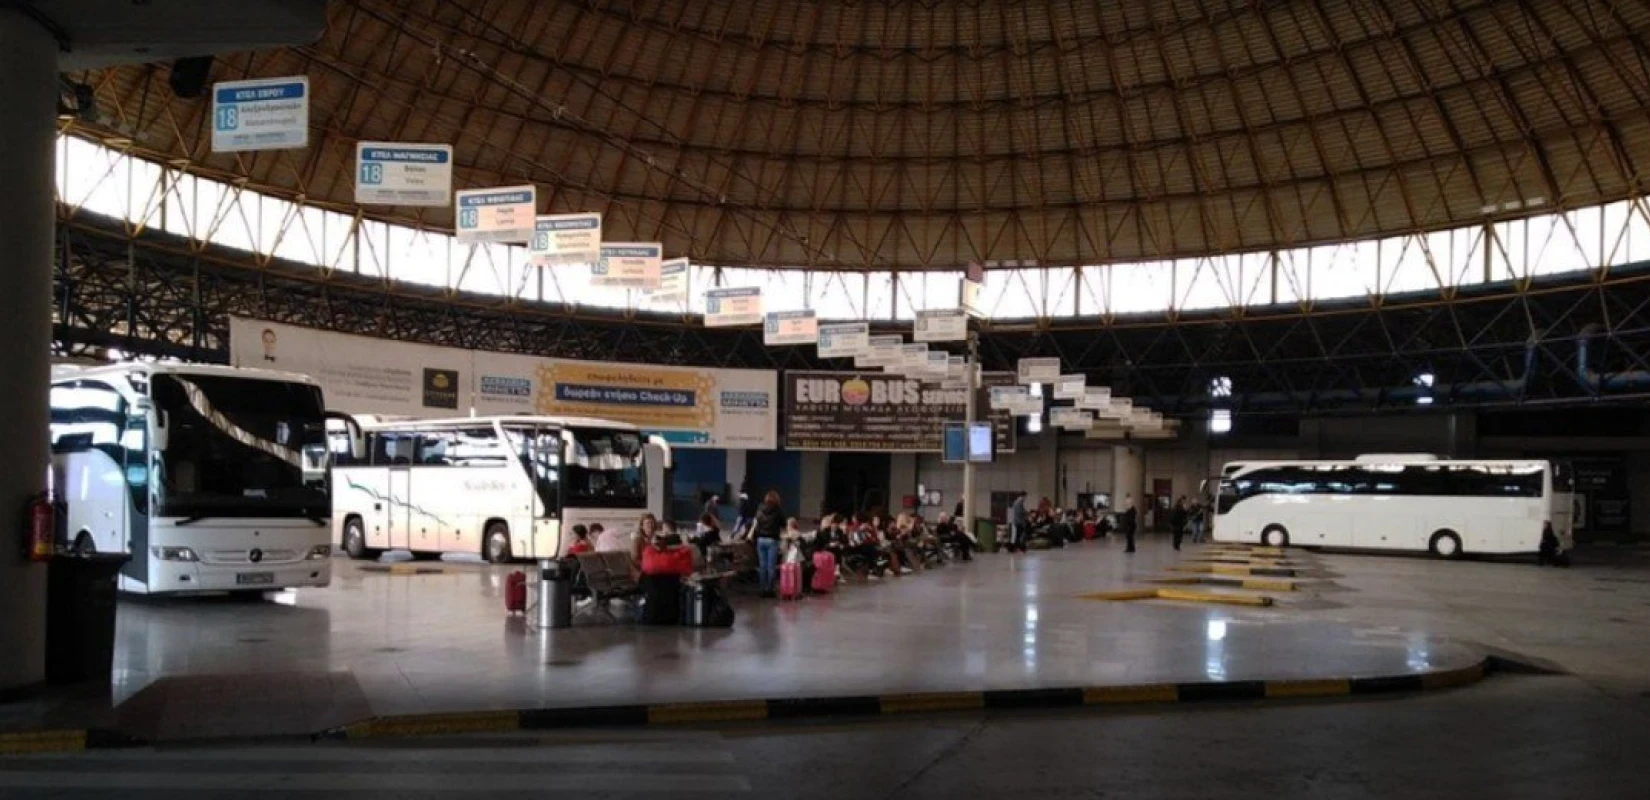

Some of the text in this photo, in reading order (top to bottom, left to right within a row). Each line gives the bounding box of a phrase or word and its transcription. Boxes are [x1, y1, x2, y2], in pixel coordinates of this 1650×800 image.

[218, 106, 237, 129] 18
[362, 164, 382, 182] 18
[462, 209, 478, 228] 18
[921, 389, 967, 404] SERVIC
